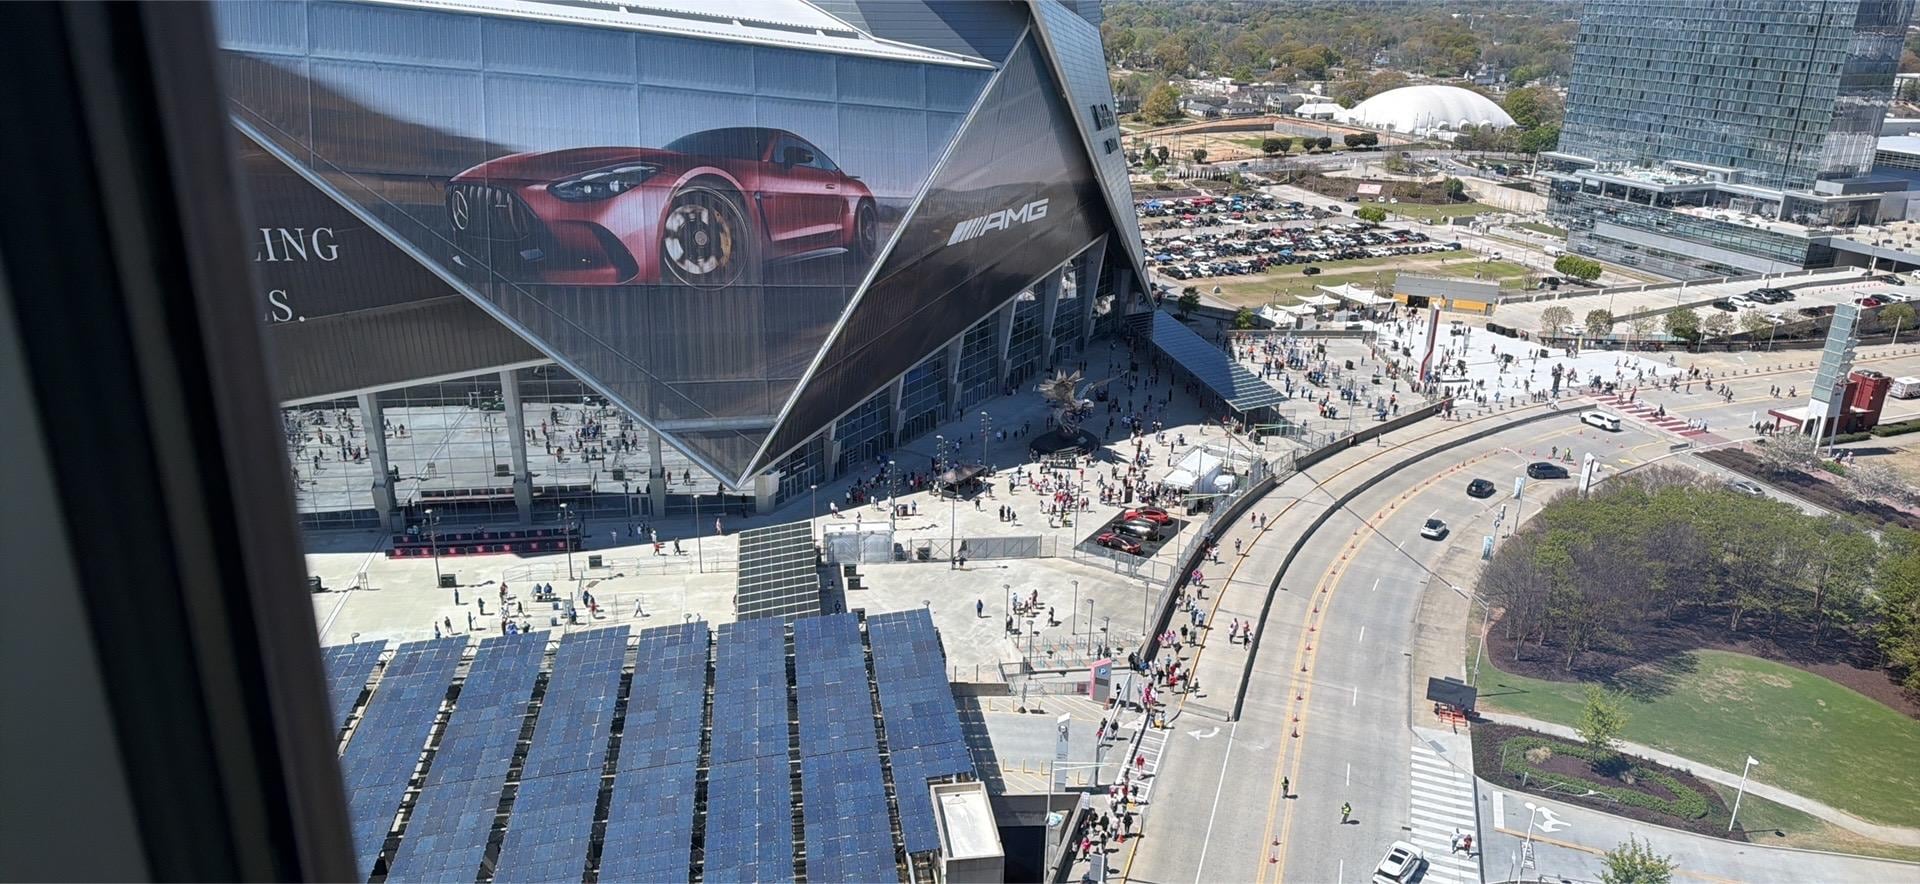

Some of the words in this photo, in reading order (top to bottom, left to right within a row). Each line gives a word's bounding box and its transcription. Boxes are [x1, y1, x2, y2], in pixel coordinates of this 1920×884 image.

[979, 197, 1049, 237] AMG
[255, 227, 339, 261] ING
[264, 289, 305, 322] S.
